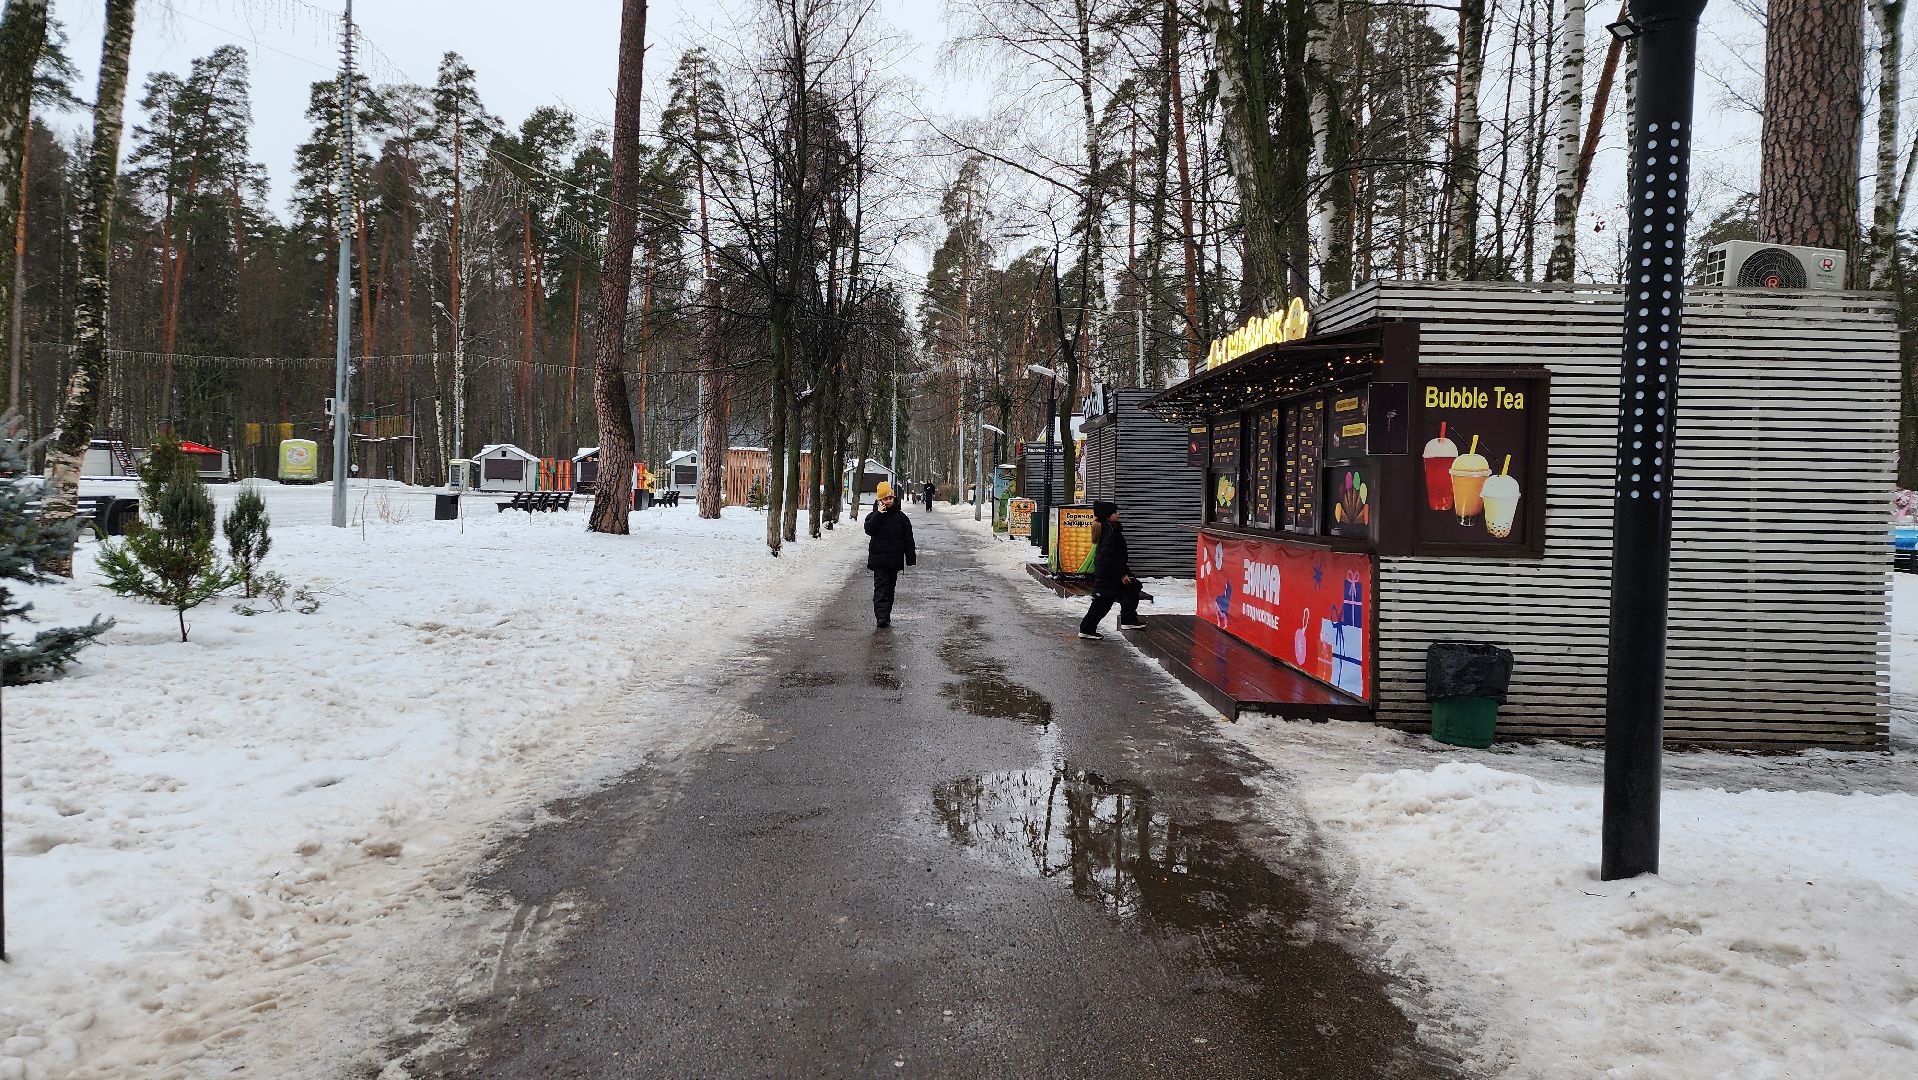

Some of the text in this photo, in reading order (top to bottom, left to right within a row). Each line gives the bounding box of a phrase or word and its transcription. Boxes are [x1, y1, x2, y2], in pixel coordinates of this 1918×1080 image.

[1425, 386, 1525, 410] Bubble Tea
[1066, 512, 1094, 521] Горячая
[1242, 558, 1281, 605] ЗИМА
